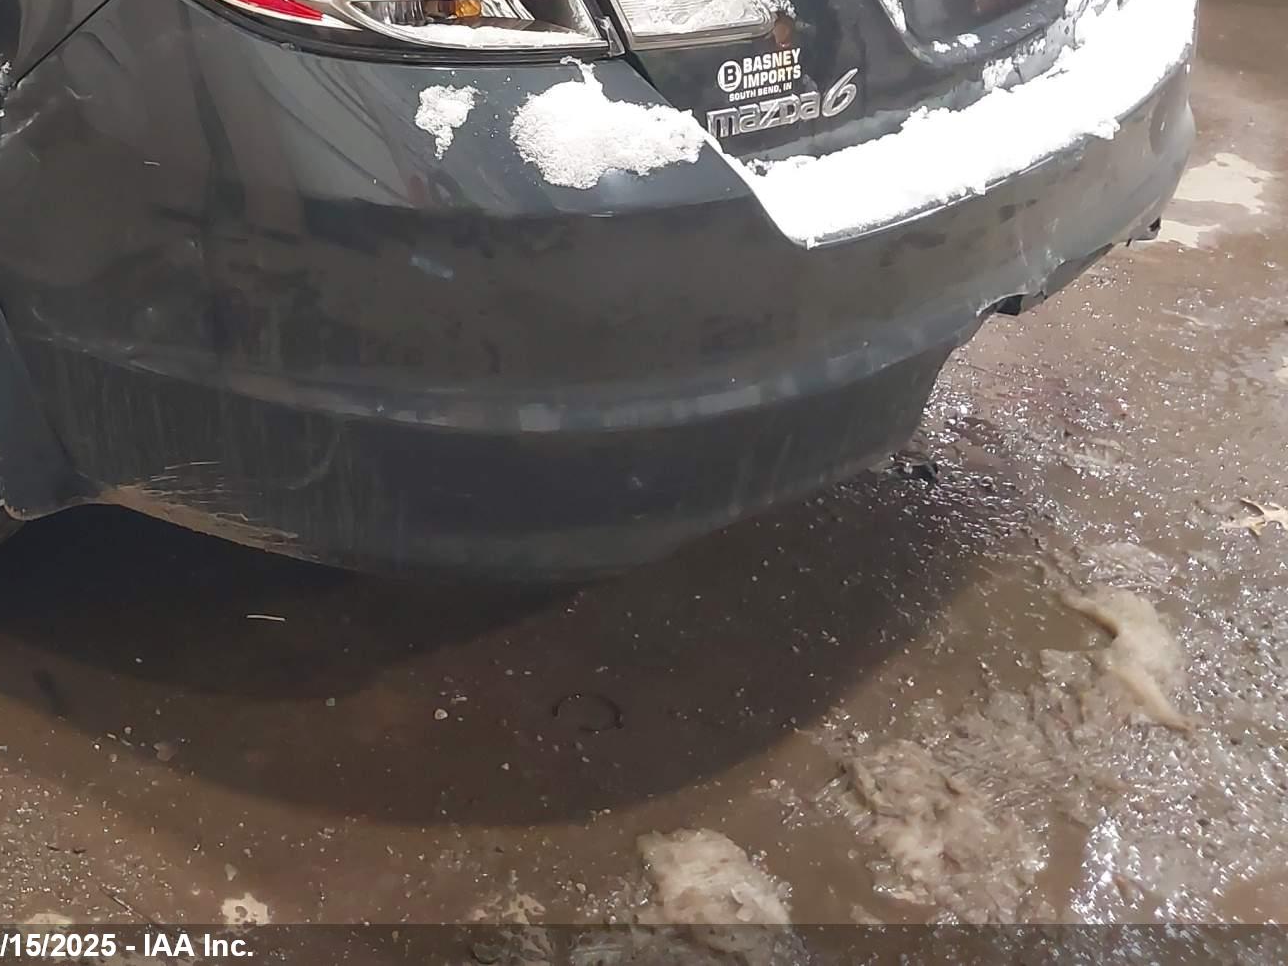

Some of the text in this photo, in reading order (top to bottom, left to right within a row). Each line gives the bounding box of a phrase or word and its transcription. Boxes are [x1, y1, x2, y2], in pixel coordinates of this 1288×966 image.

[742, 47, 801, 74] BASNEY
[743, 64, 802, 89] IMPORTS
[728, 81, 793, 102] SOUTH BEND, IN
